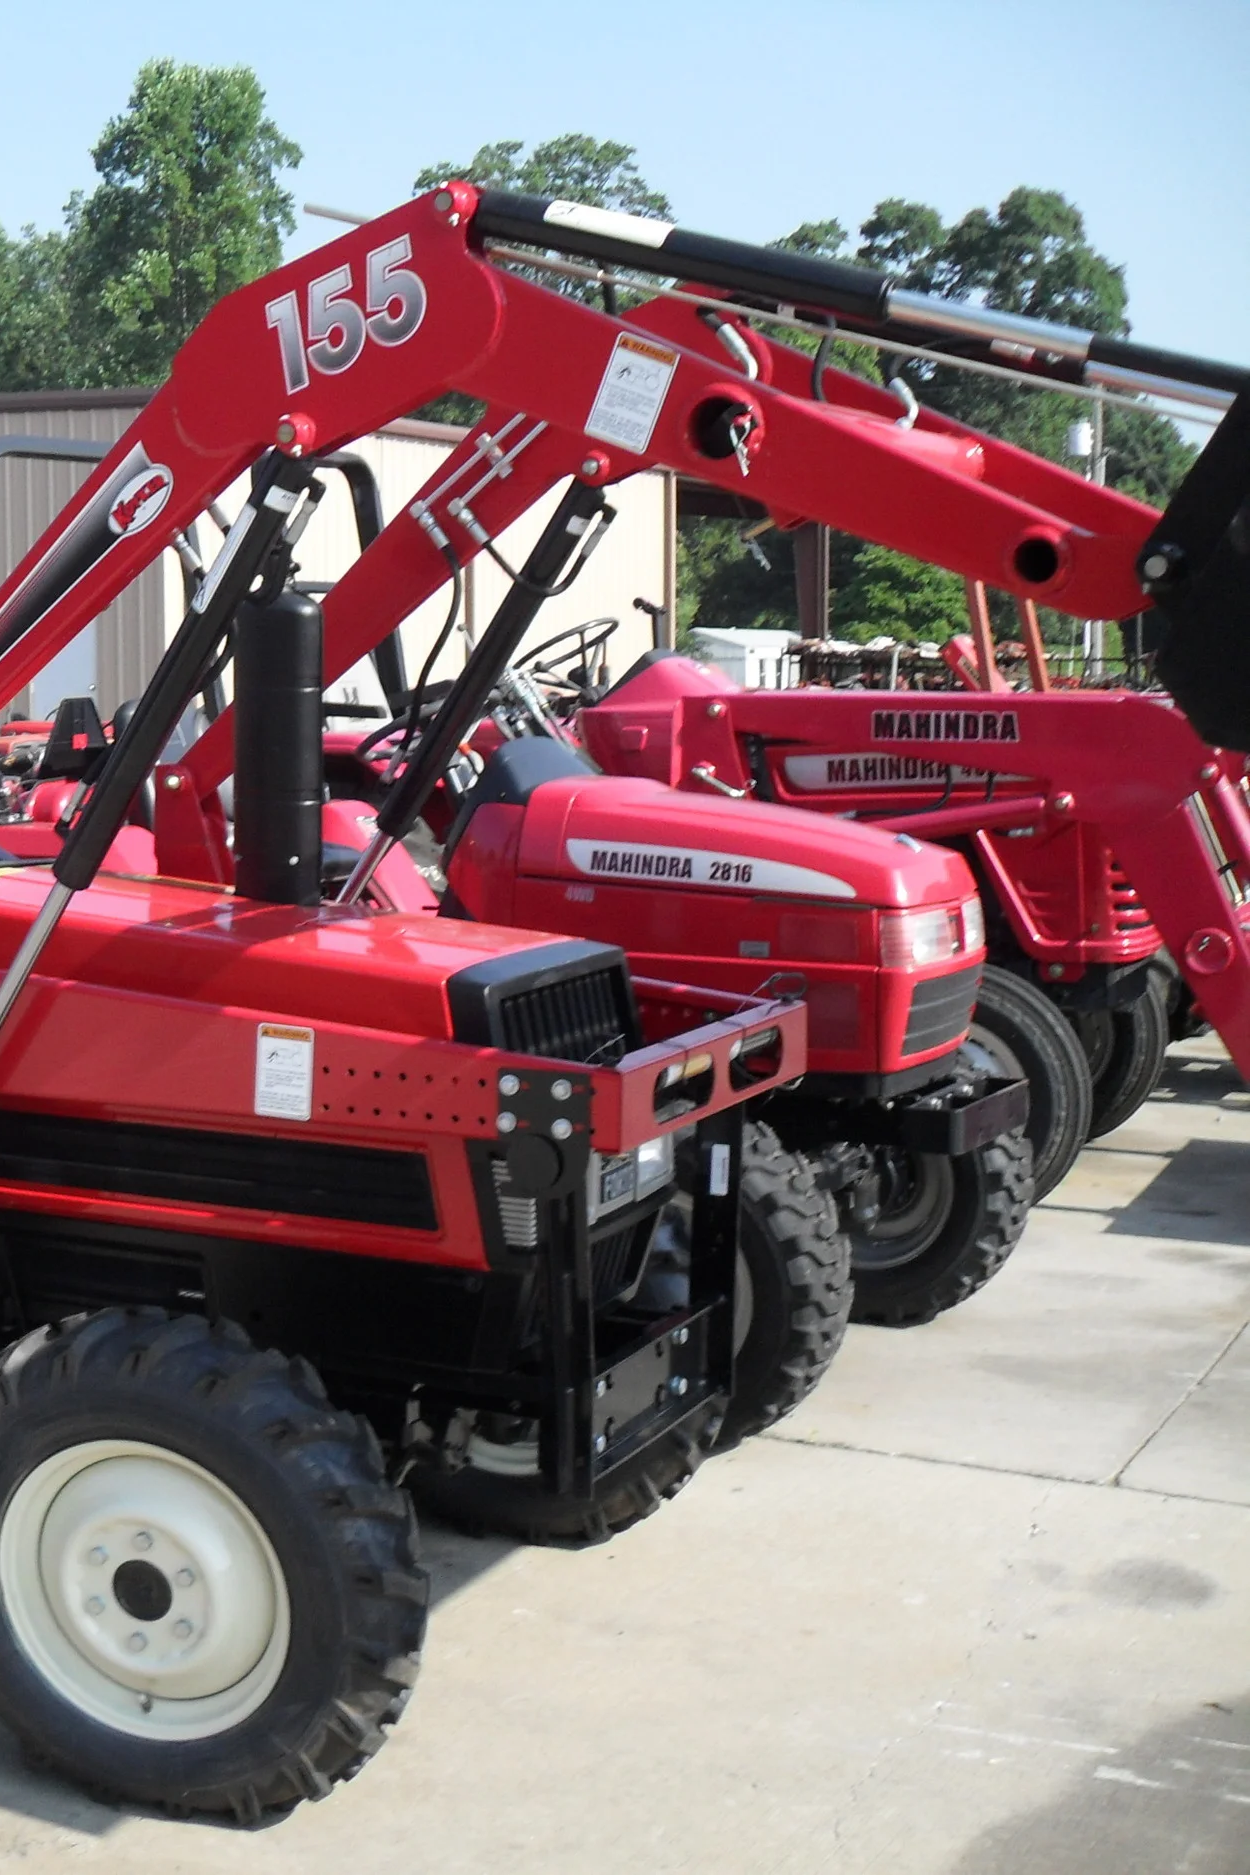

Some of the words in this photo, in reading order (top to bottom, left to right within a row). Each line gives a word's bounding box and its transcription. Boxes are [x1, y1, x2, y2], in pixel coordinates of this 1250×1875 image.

[265, 233, 427, 395] 155
[871, 710, 1020, 743] MAHINDRA
[590, 851, 692, 878] MAHINDRA
[709, 861, 753, 883] 2816
